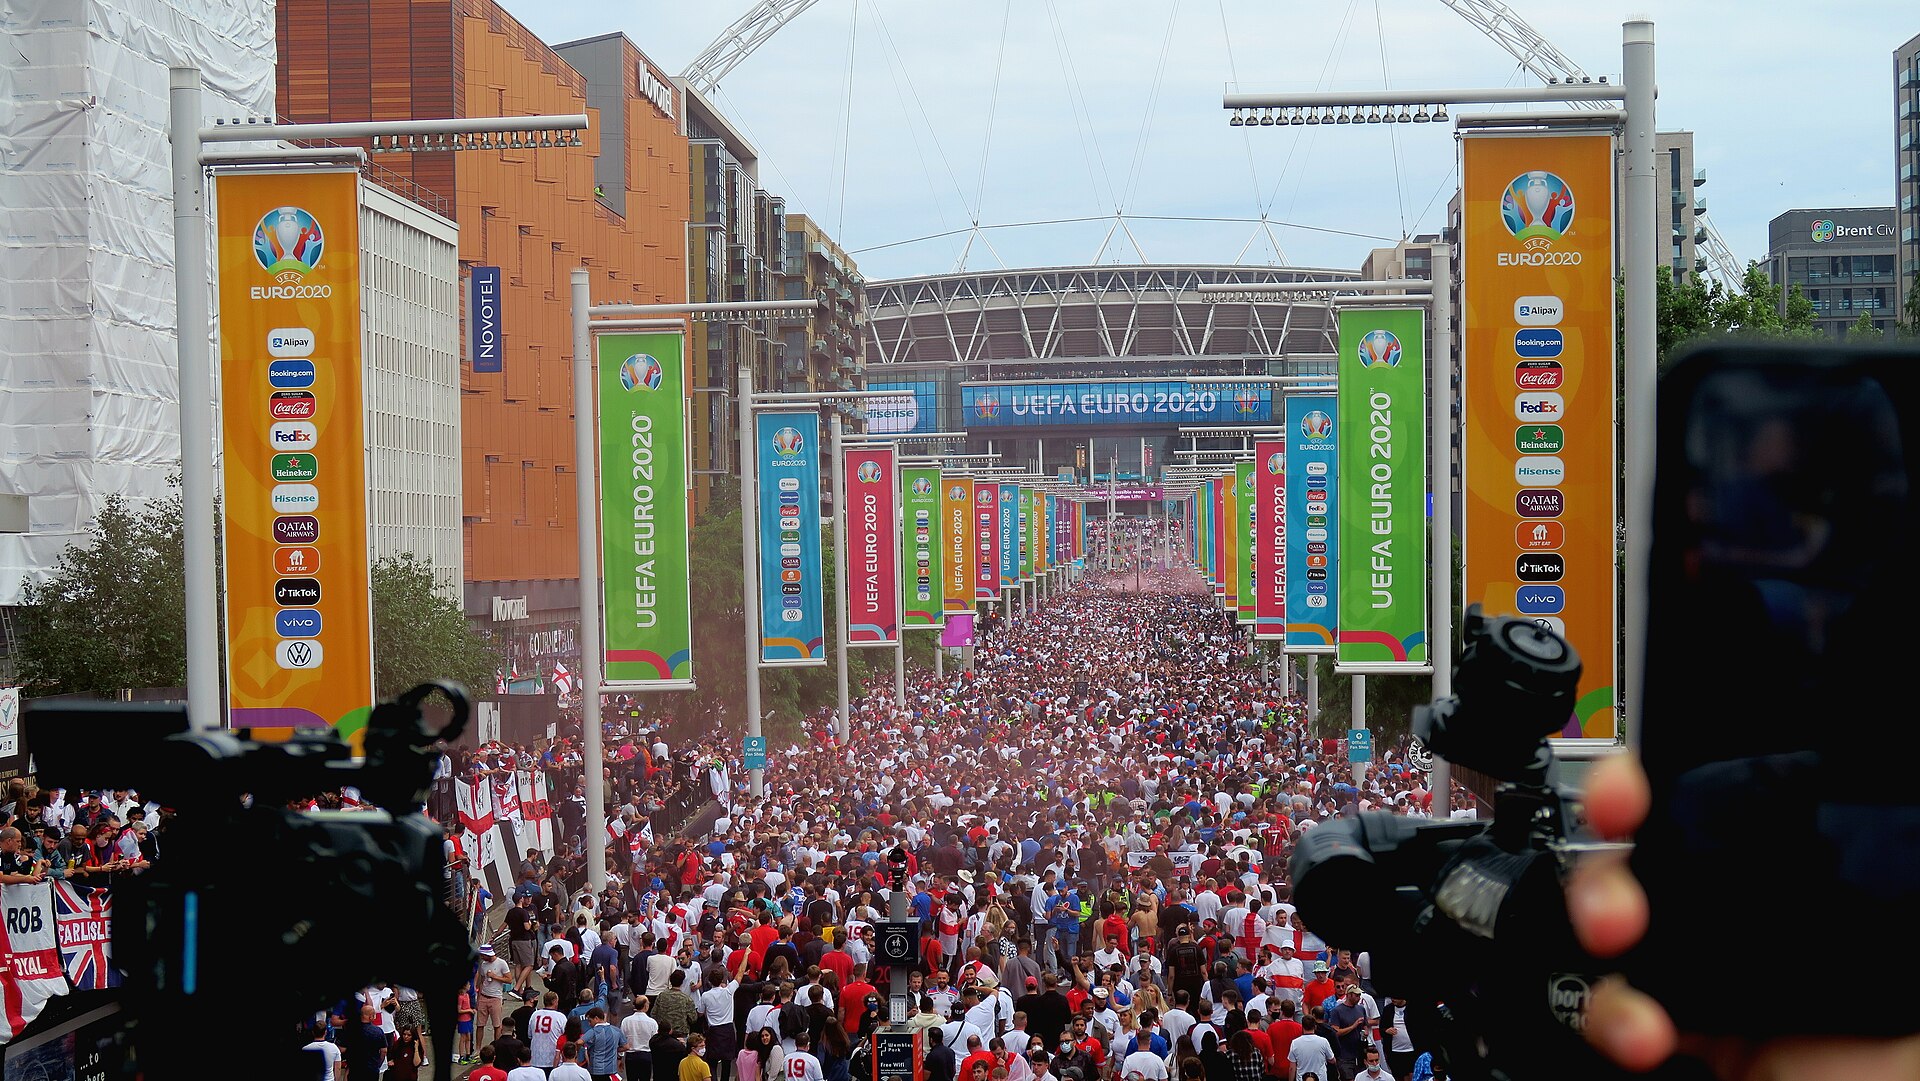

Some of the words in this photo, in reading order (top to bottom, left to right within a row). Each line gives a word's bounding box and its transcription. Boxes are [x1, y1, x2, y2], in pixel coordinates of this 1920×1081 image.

[639, 59, 675, 119] NOVOTEL
[1836, 225, 1873, 237] Brent
[1876, 224, 1895, 236] Civ
[1525, 240, 1551, 250] UEFA
[1497, 251, 1582, 266] EURO2020
[276, 273, 301, 284] UEFA
[250, 285, 332, 300] EURO2020
[480, 273, 494, 358] NOVOTEL
[1530, 306, 1558, 316] Alipay
[283, 338, 309, 347] Alipay
[1517, 338, 1561, 347] Booking.com
[270, 370, 313, 378] Booking.com
[1520, 372, 1559, 385] Coca-Cola
[274, 401, 311, 415] Coca-Cola
[1012, 394, 1077, 416] UEFA
[1081, 392, 1149, 414] EURO
[1153, 392, 1216, 413] 2020
[1520, 402, 1557, 413] FedEx
[1370, 392, 1392, 460] 2020
[275, 430, 310, 443] FedEx
[632, 415, 653, 481] 2020
[1520, 441, 1559, 449] Heineken
[276, 468, 312, 477] Heineken
[1518, 468, 1561, 476] Hisense
[274, 494, 315, 503] Hisense
[1274, 487, 1286, 523] 2020
[1371, 463, 1393, 535] EURO
[1520, 495, 1559, 506] QATAR
[634, 485, 655, 556] EURO
[864, 494, 877, 532] 2020
[278, 522, 314, 532] QATAR
[953, 509, 963, 535] 2020
[286, 530, 315, 538] AIRWAYS
[865, 533, 878, 572] EURO
[954, 536, 963, 564] EURO
[1274, 525, 1286, 565] EURO
[1003, 550, 1011, 571] UEFA
[1372, 538, 1393, 609] UEFA
[1530, 565, 1561, 573] TikTok
[955, 564, 963, 591] UEFA
[288, 589, 317, 597] TikTok
[867, 574, 879, 613] UEFA
[1275, 567, 1286, 605] UEFA
[637, 560, 656, 629] UEFA
[1525, 594, 1555, 603] vivo
[492, 595, 529, 622] NOVOTEL
[284, 618, 314, 626] vivo
[529, 629, 561, 658] GOURMET
[1271, 833, 1278, 845] 7
[7, 905, 43, 934] ROB
[58, 919, 112, 945] CARLISLE
[848, 925, 862, 941] 19
[534, 1015, 552, 1033] 19
[787, 1058, 805, 1078] 19
